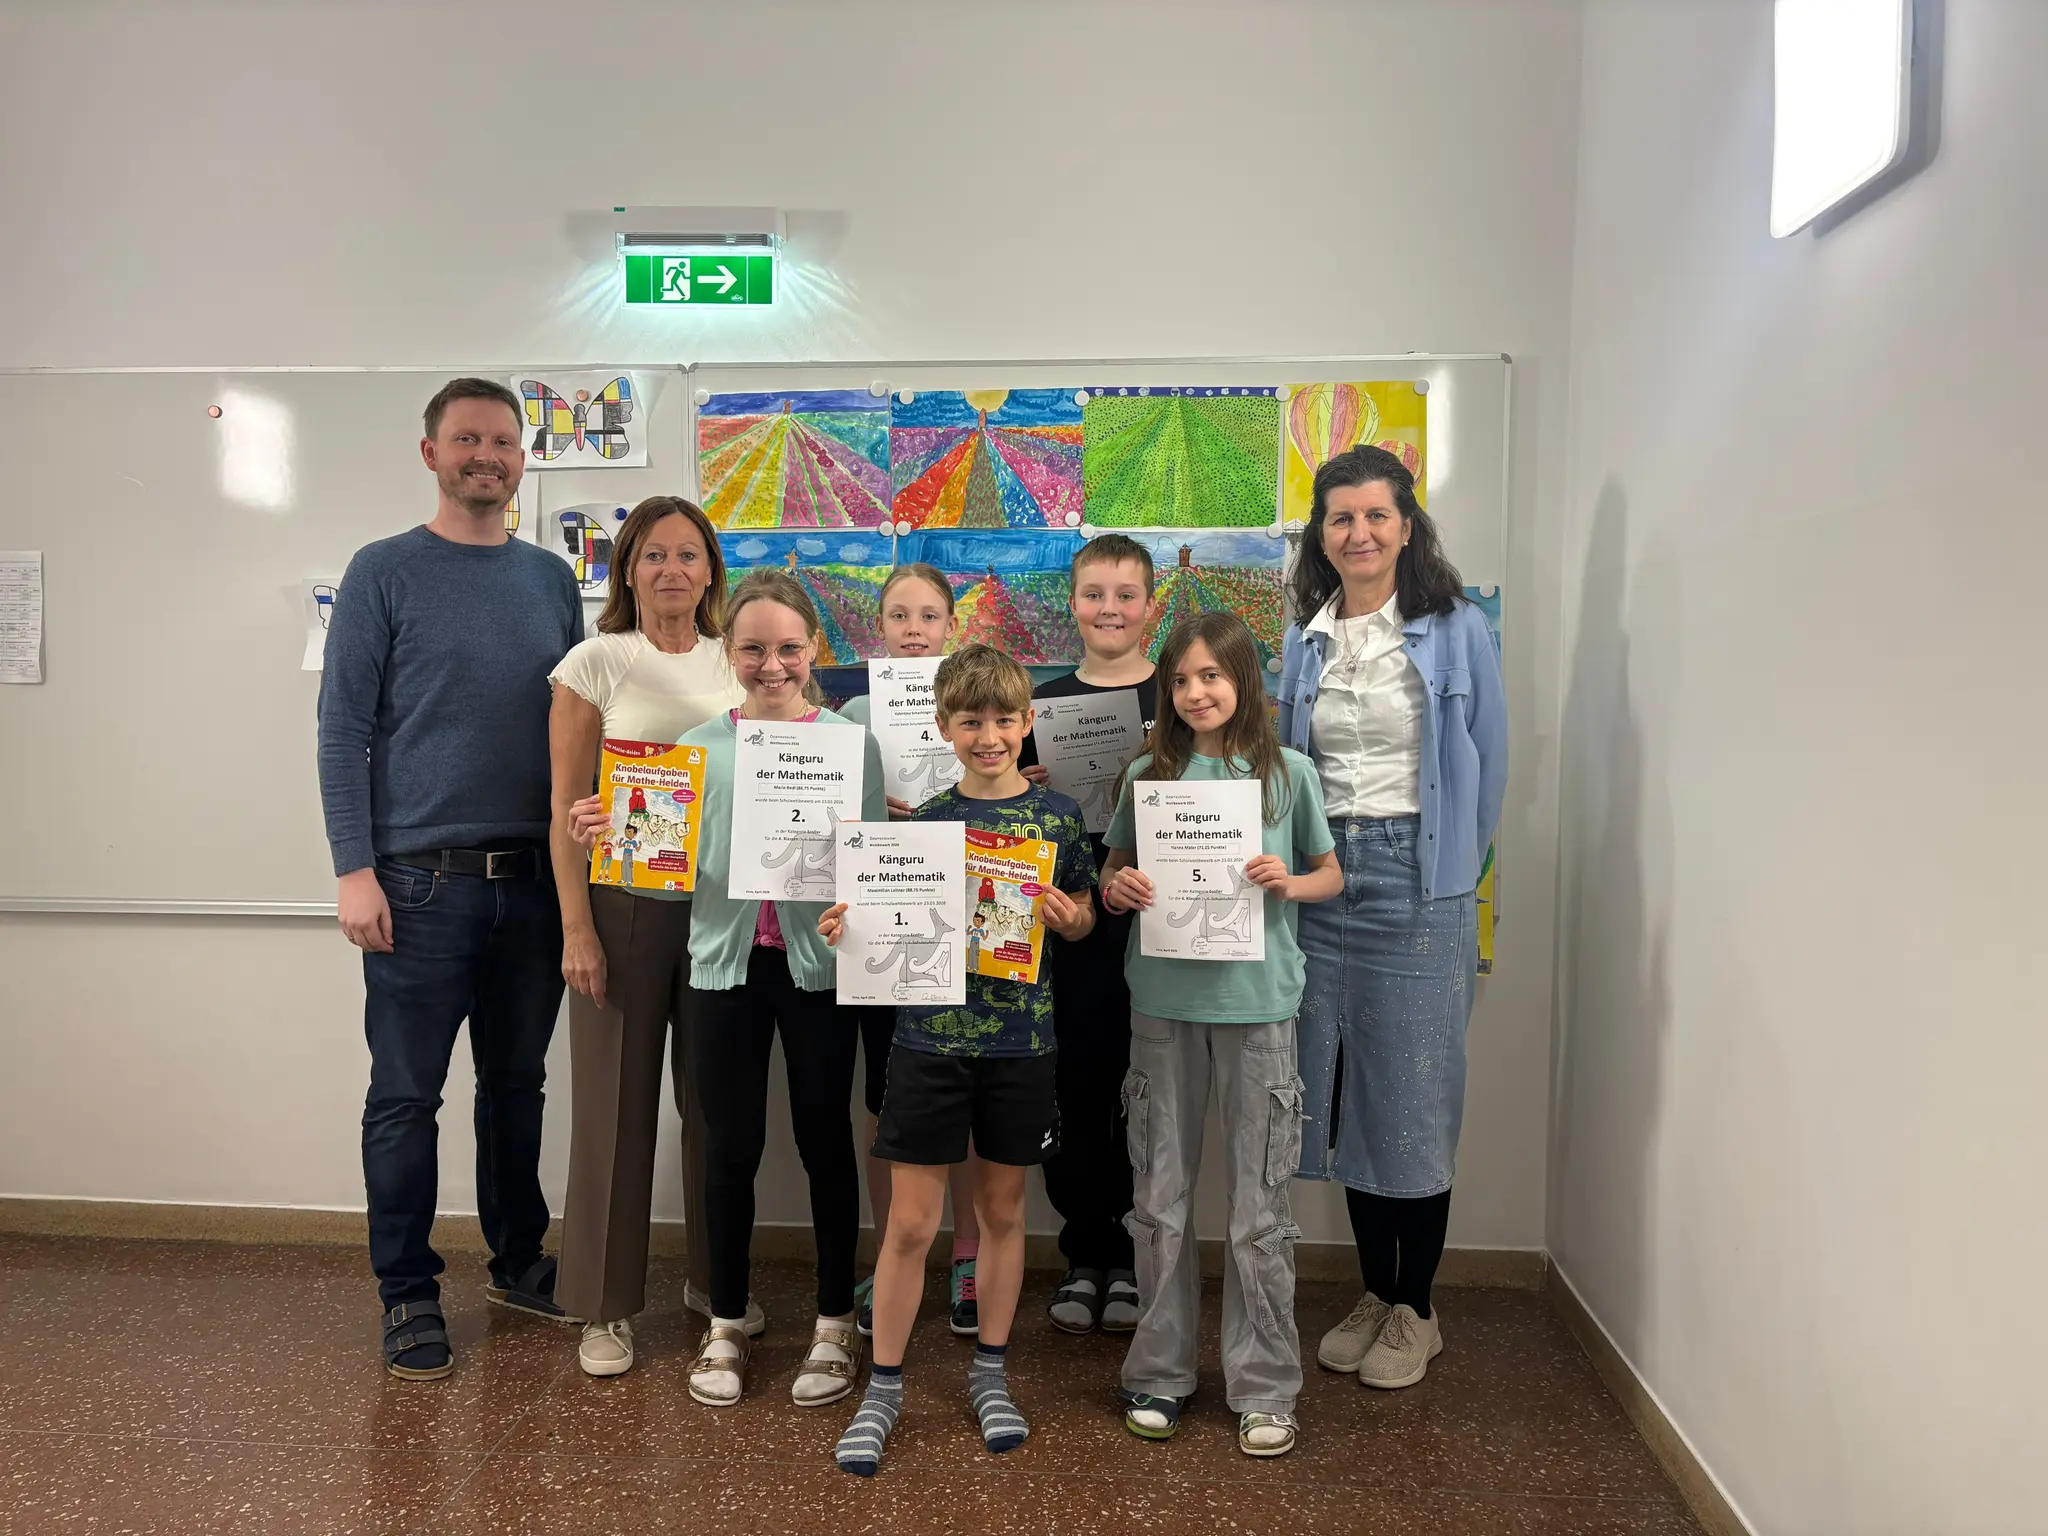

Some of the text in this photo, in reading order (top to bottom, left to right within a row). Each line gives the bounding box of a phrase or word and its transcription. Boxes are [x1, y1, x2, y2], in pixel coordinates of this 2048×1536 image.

[906, 684, 934, 693] Kängu
[889, 698, 937, 707] der Mathe
[1078, 714, 1117, 726] Känguru
[921, 730, 934, 742] 4.
[1052, 726, 1127, 743] der Mathematik
[691, 750, 699, 758] 4.
[779, 753, 824, 765] Känguru
[616, 764, 688, 778] Knobelaufgaben
[1089, 760, 1102, 771] 5.
[756, 769, 844, 781] der Mathematik
[612, 774, 690, 789] für Mathe-Helden
[792, 809, 806, 822] 2.
[1176, 813, 1220, 824] Känguru
[1156, 829, 1242, 839] der Mathematik
[1040, 845, 1048, 854] 4.
[879, 855, 924, 866] Känguru
[969, 852, 1037, 871] Knobelaufgaben
[858, 872, 946, 882] der Mathematik
[965, 862, 1038, 882] für Mathe-Helden
[1192, 869, 1206, 882] 5.
[895, 912, 909, 926] 1.
